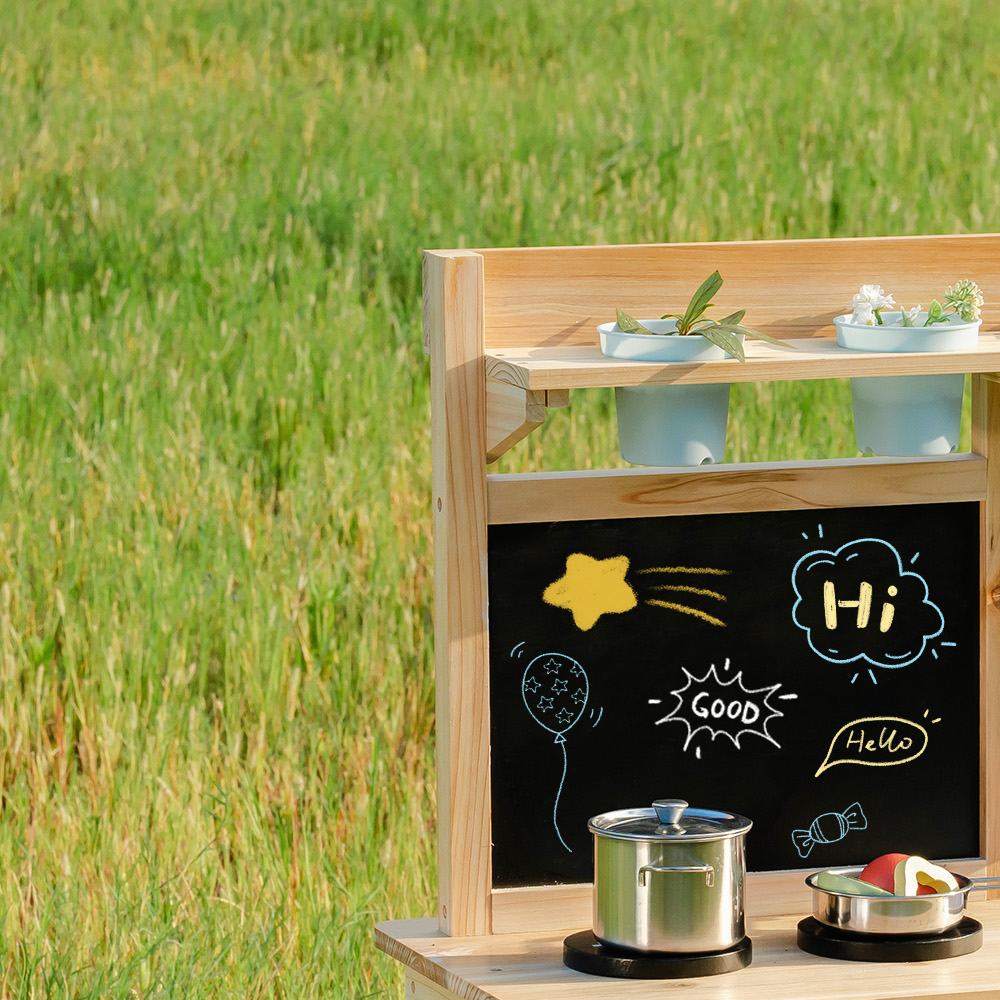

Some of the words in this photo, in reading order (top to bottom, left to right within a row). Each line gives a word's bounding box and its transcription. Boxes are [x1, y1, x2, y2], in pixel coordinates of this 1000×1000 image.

[823, 580, 898, 633] Hi
[691, 691, 760, 724] GOOD
[846, 726, 913, 753] Hello
